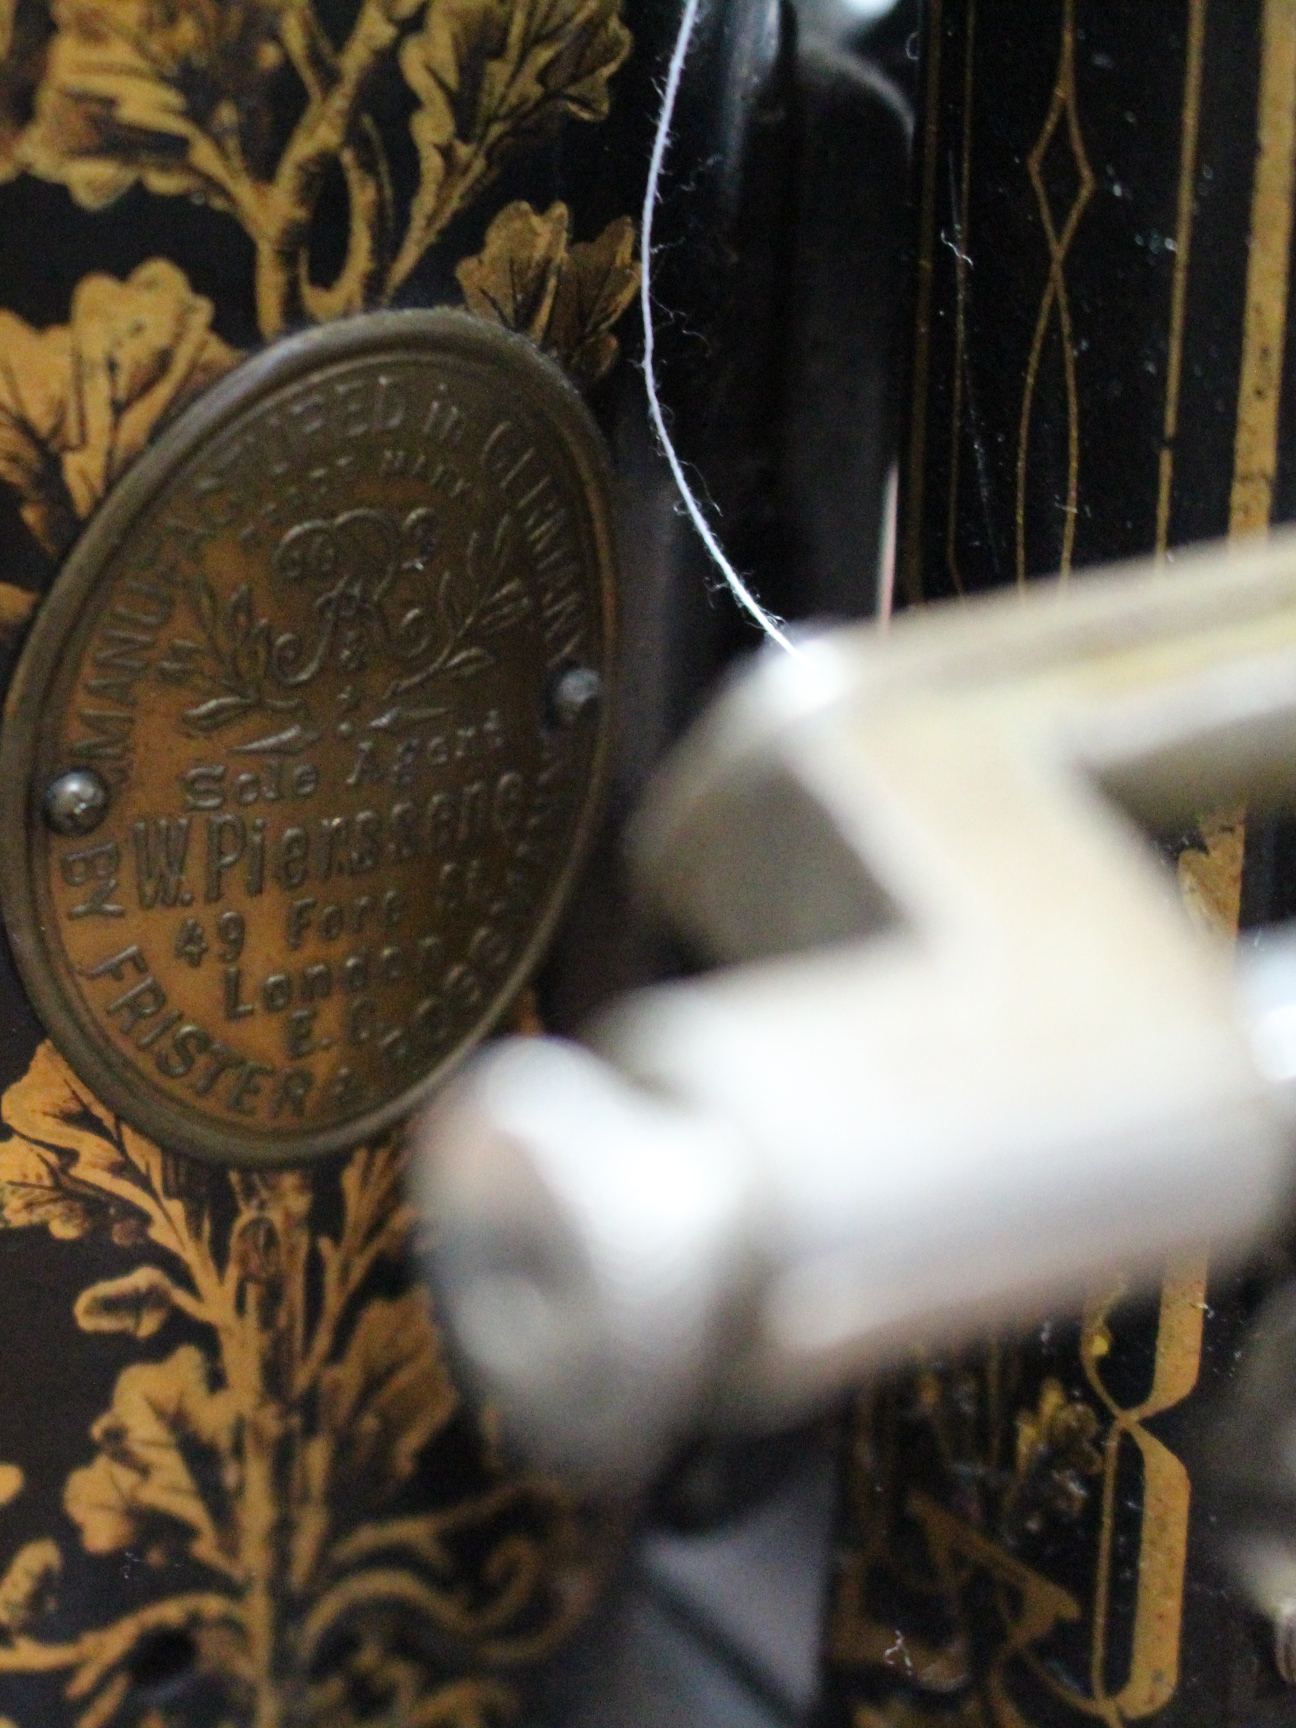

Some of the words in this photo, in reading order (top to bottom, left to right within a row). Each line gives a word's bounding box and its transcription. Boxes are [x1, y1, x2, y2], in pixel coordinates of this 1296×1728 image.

[178, 757, 320, 812] Sole
[60, 841, 126, 921] BY
[175, 911, 247, 969] 49
[224, 934, 443, 1021] London
[77, 943, 316, 1118] FRISTER
